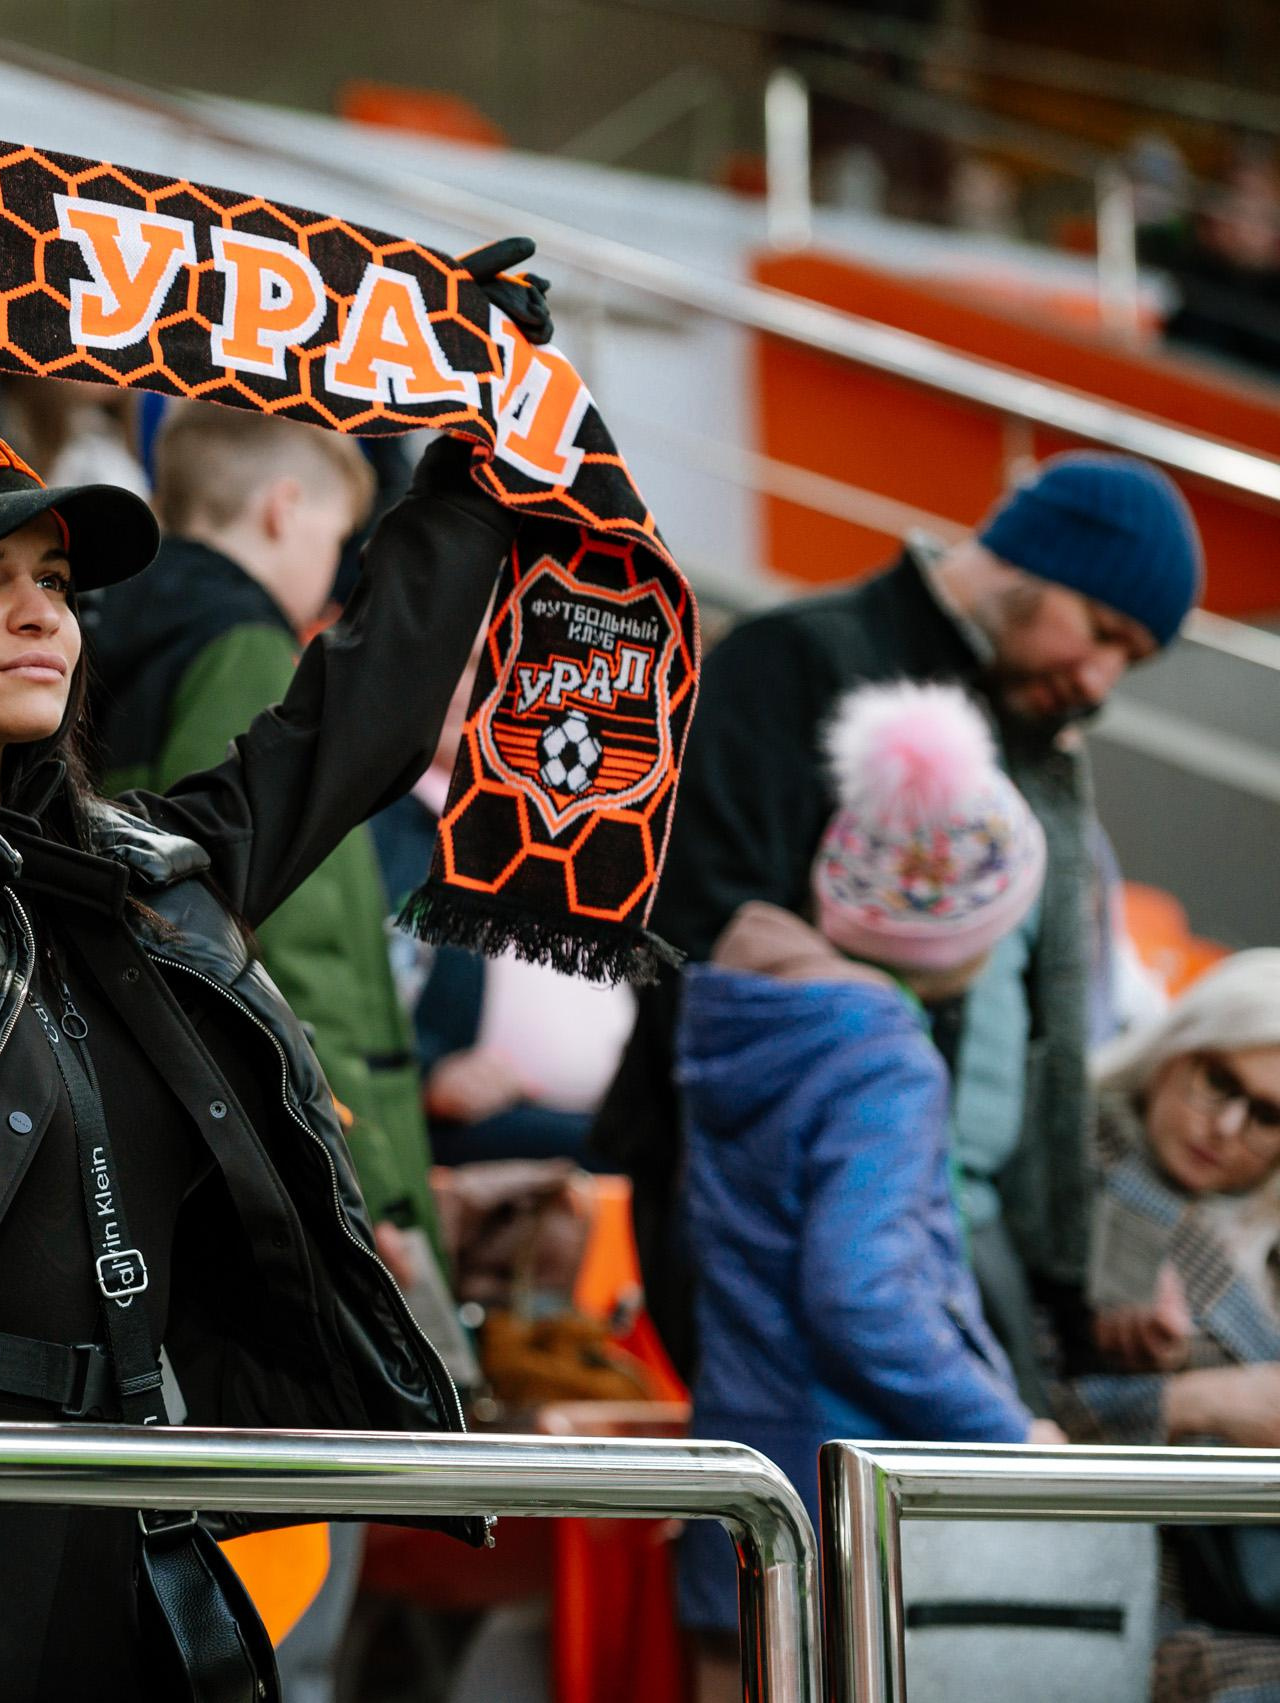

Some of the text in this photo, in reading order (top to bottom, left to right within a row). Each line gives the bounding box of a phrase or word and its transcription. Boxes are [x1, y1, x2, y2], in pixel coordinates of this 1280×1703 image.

[531, 599, 659, 641] ФУТБОЛЬНЫЙ
[568, 622, 616, 651] КЛУБ
[516, 646, 651, 714] УРАЛ
[91, 1146, 116, 1216] Klein
